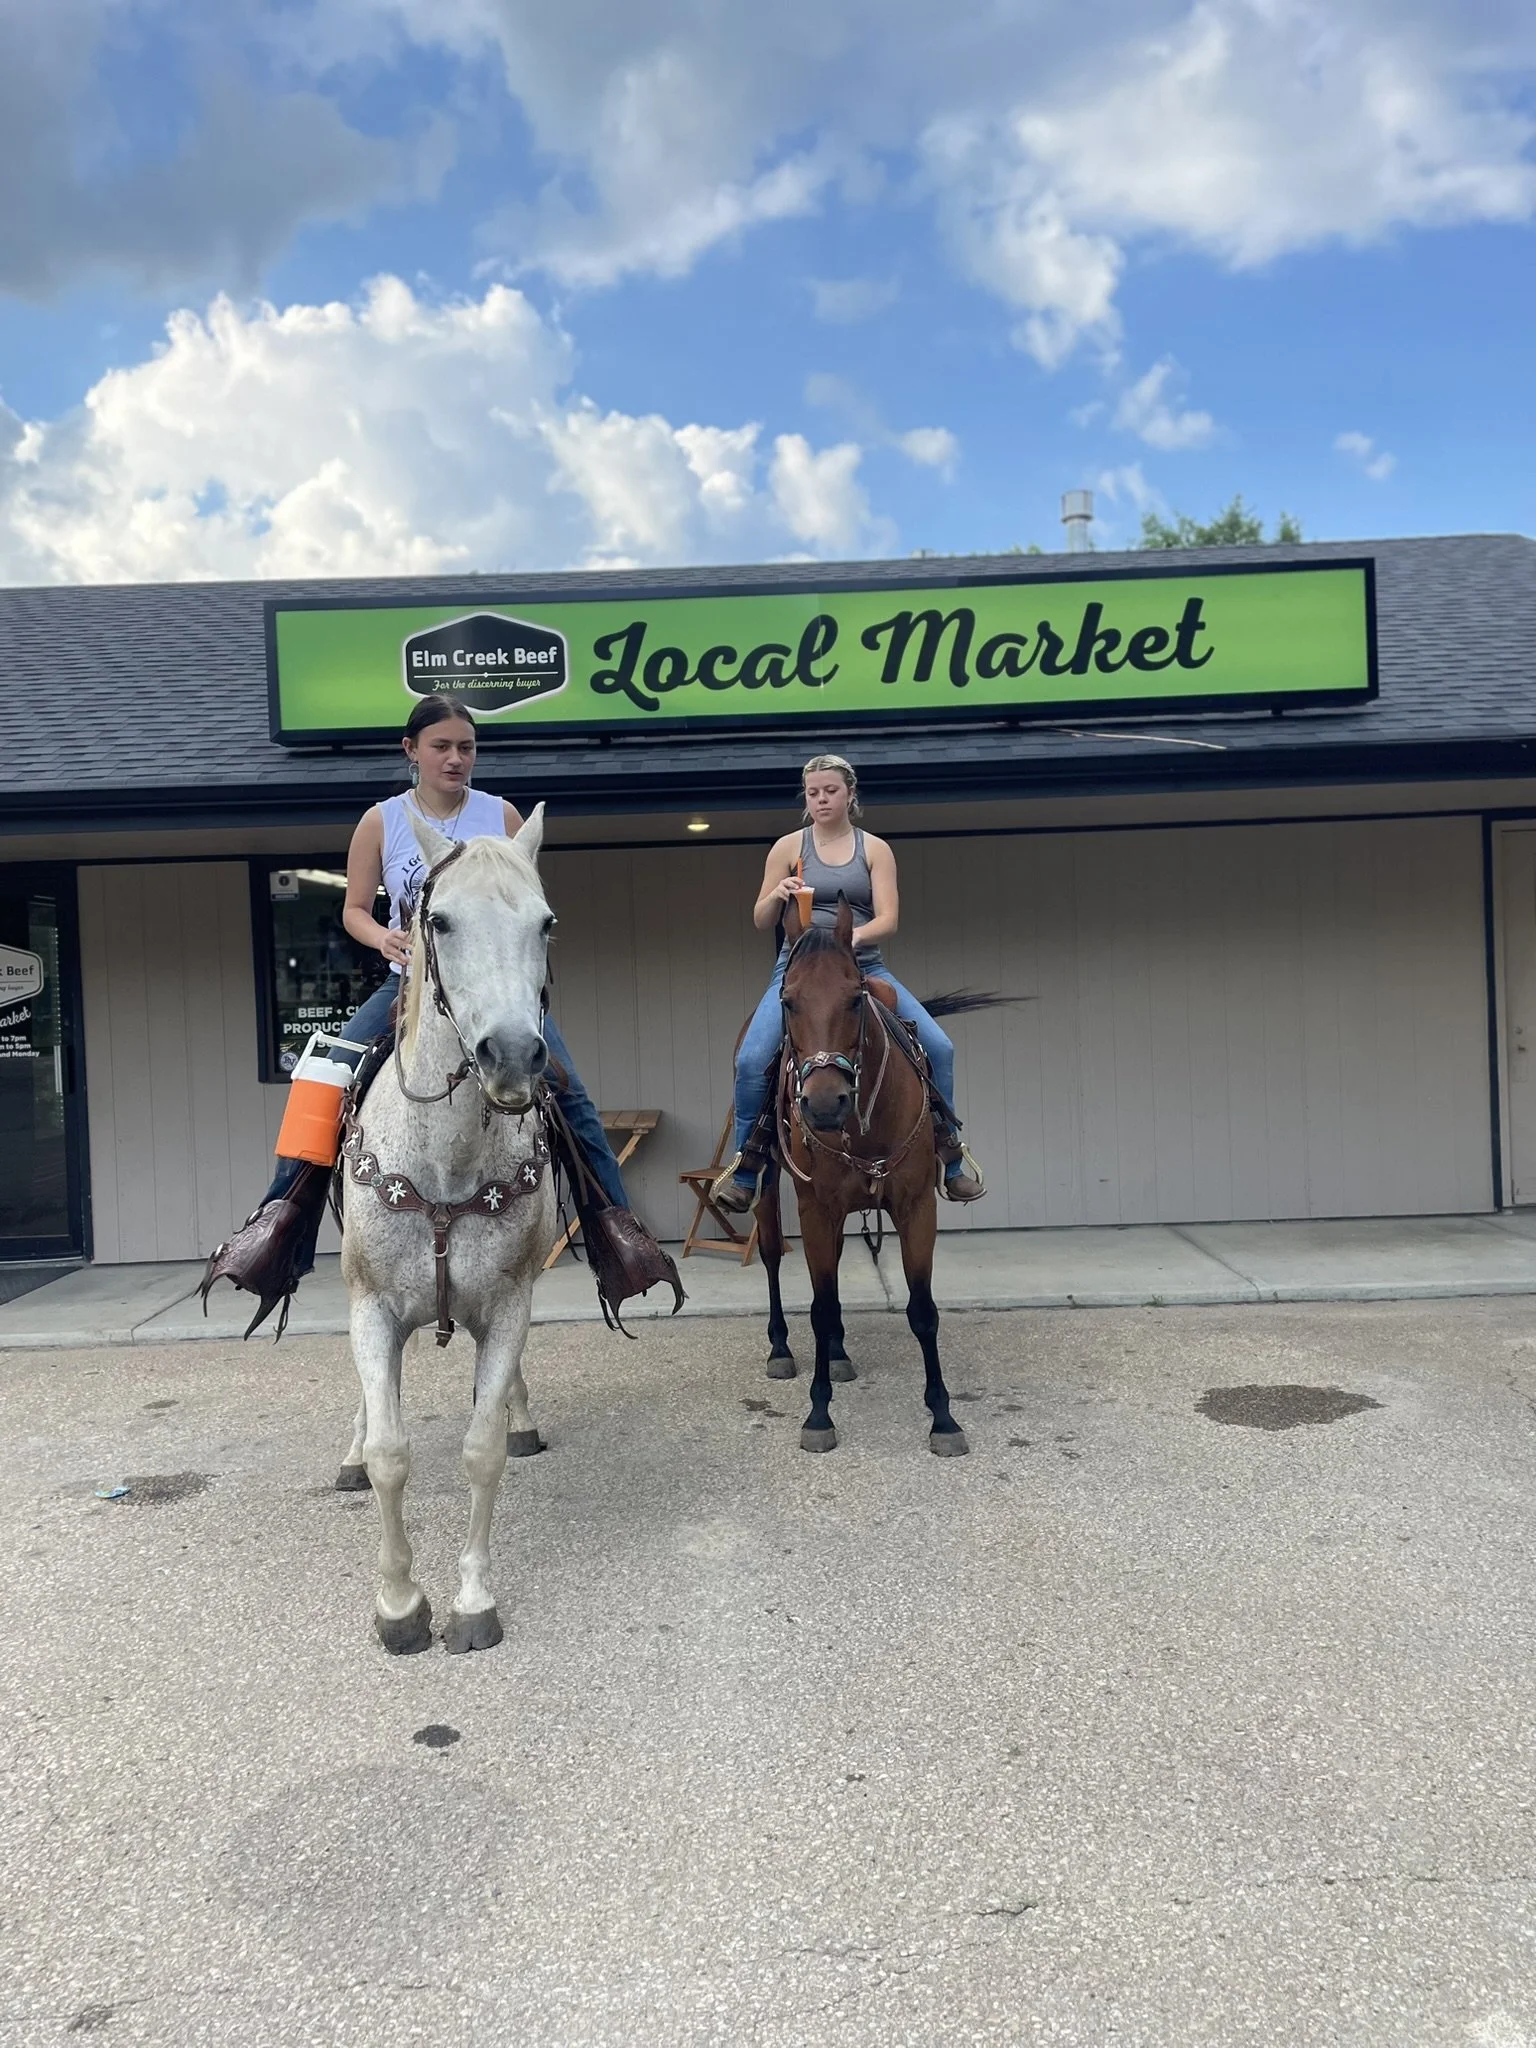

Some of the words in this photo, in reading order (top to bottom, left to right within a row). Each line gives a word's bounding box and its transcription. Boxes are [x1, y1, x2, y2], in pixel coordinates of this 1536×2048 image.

[412, 650, 447, 668] Elm
[453, 648, 509, 667] Creek
[514, 646, 558, 665] Beef
[590, 614, 840, 712] Local
[861, 597, 1215, 688] Market
[432, 680, 450, 691] For
[452, 680, 466, 689] the
[467, 679, 514, 690] discerning
[516, 678, 541, 689] buyer
[6, 965, 35, 976] Beef
[0, 1006, 32, 1028] arket
[298, 1007, 333, 1018] BEEF
[12, 1050, 40, 1058] Monday
